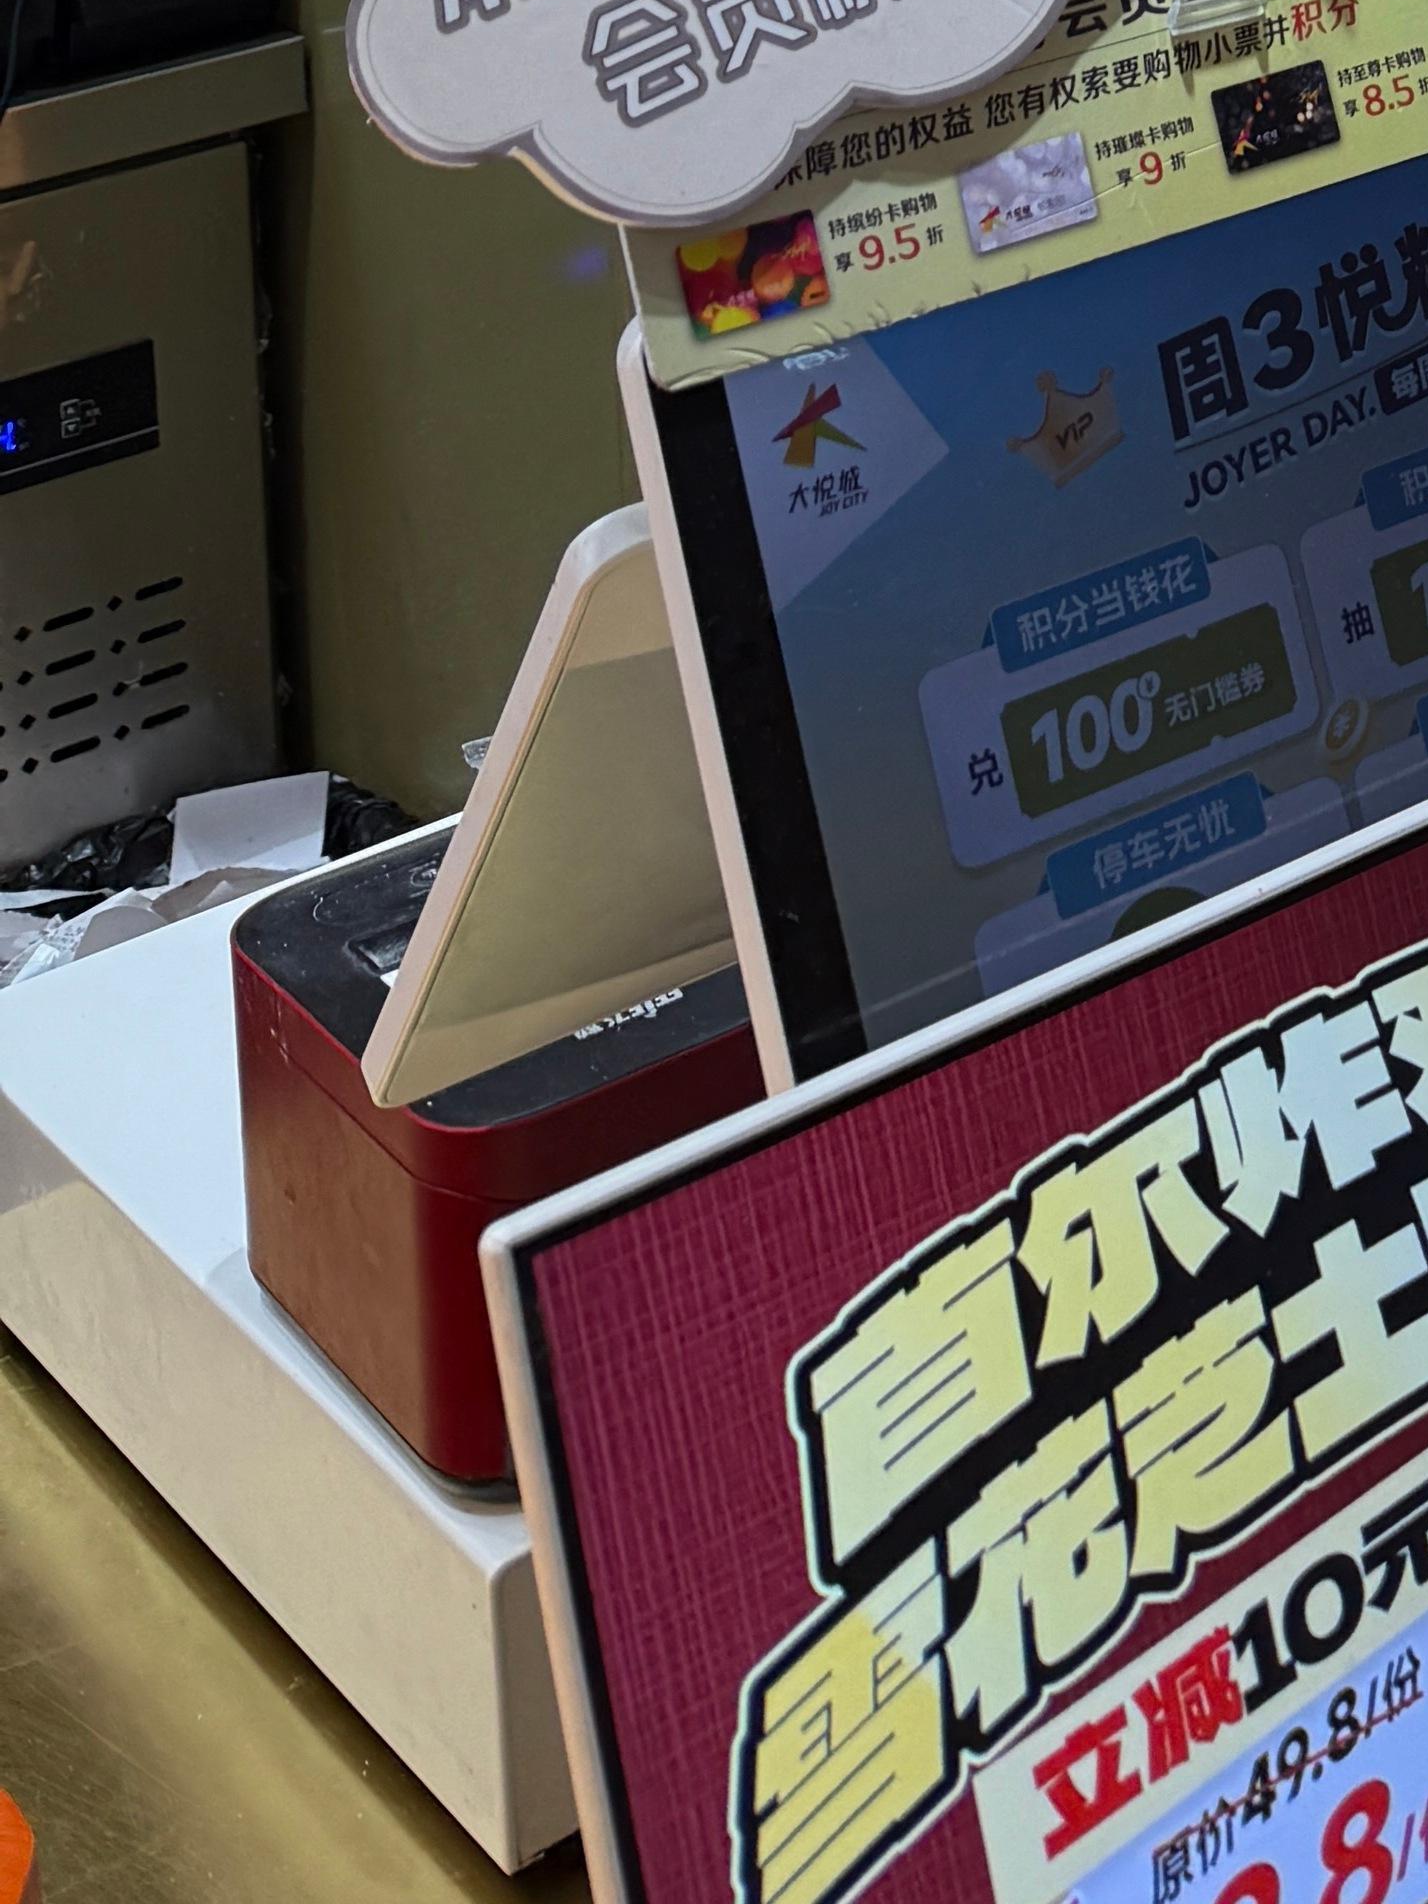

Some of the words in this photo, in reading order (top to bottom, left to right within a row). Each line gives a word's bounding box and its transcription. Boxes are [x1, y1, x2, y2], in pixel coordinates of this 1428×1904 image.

[1336, 46, 1427, 89] 持至尊卡购物
[1094, 116, 1195, 163] 持璀璨卡购物
[827, 192, 939, 241] 持缤纷卡购物
[1055, 410, 1094, 452] VIP
[787, 466, 861, 514] 大悦城
[1184, 427, 1301, 513] JOYER
[1015, 555, 1198, 653] 积分当钱花
[1341, 605, 1374, 644] 抽
[967, 750, 1004, 794] 兑
[1164, 662, 1265, 726] 无门槛券
[1091, 797, 1237, 892] 停车无忧
